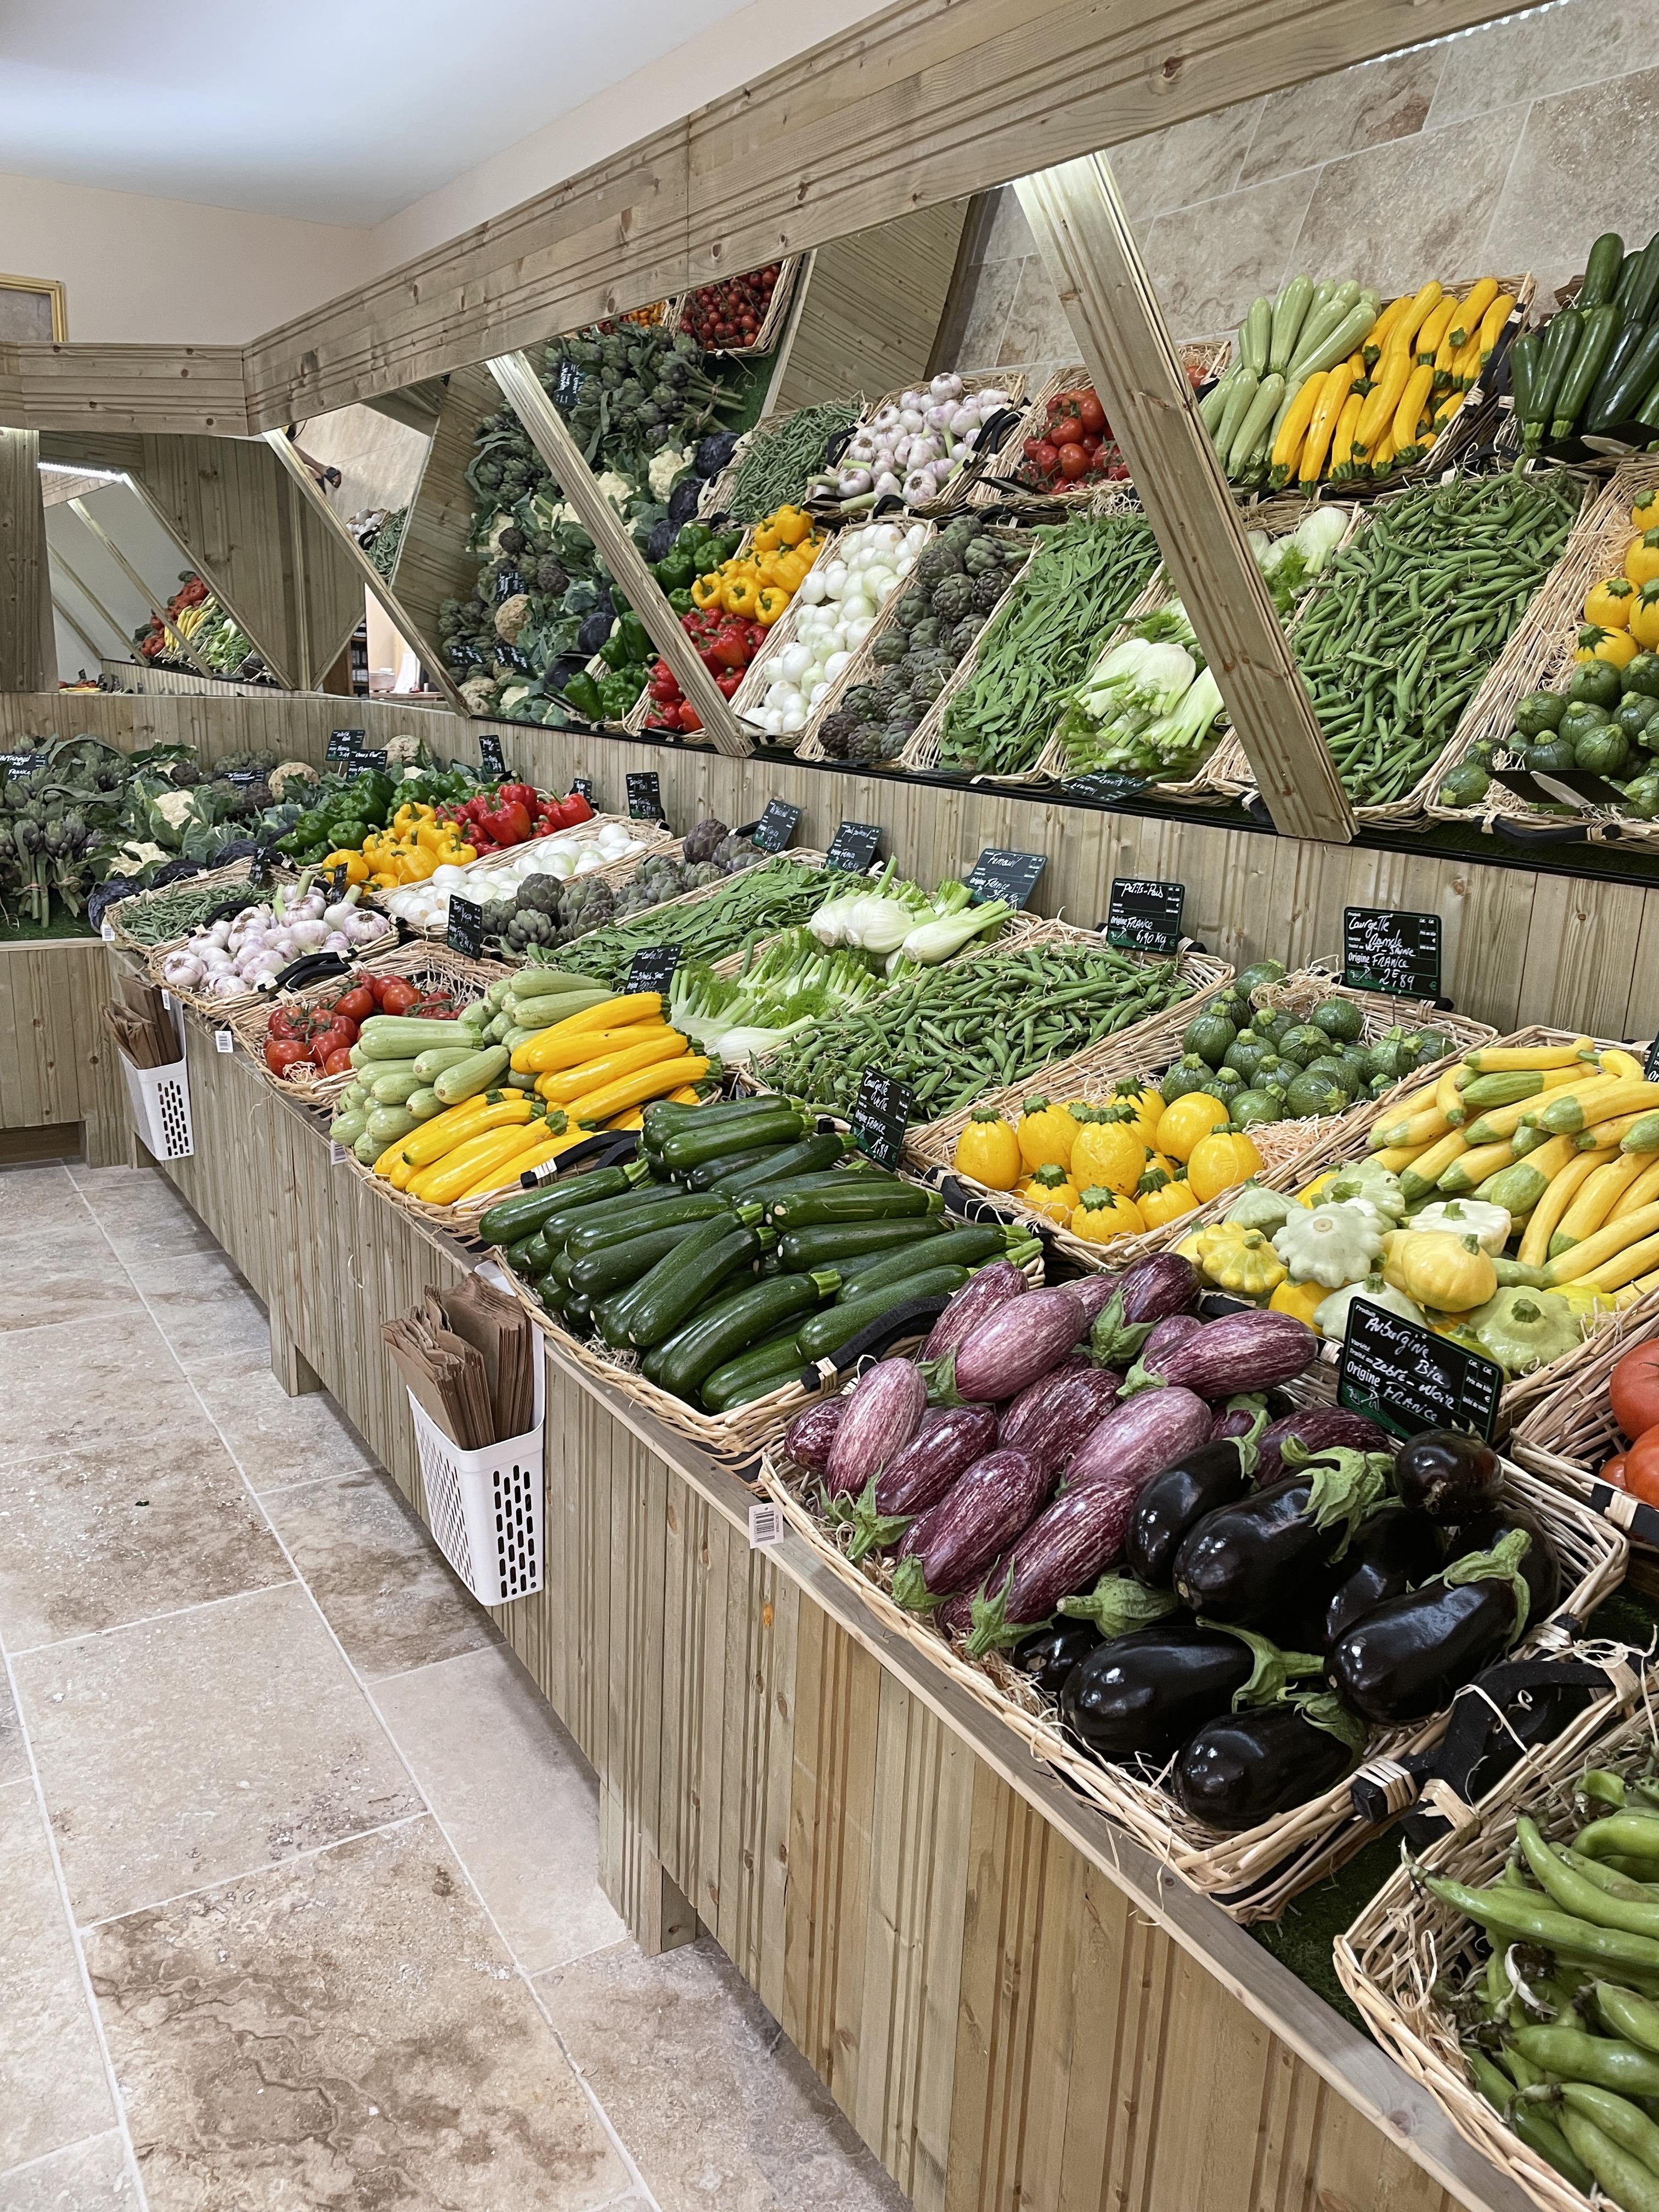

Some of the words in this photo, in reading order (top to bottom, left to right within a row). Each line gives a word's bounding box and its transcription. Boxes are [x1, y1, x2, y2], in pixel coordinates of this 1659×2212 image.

[1110, 916, 1127, 926] Origine
[1348, 952, 1370, 963] Origine
[1347, 1361, 1381, 1387] Origine
